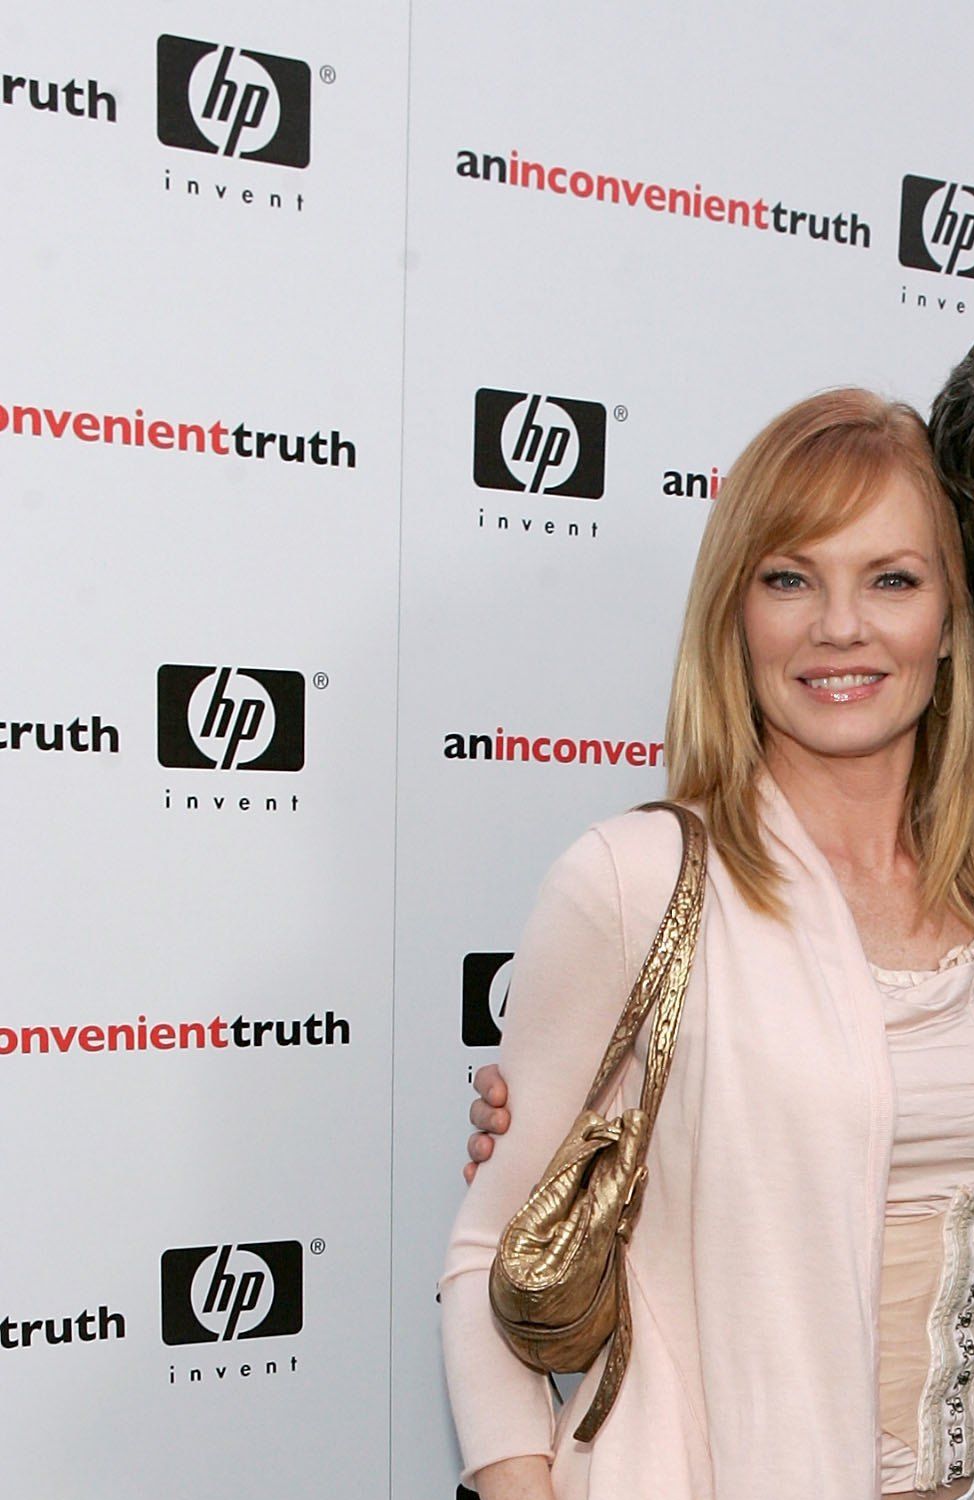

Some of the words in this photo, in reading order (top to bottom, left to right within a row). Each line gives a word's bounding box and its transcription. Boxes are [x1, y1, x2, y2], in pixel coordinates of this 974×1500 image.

[165, 170, 303, 211] invent
[456, 150, 870, 248] aninconvenienttruth
[0, 405, 356, 468] nvenienttruth
[480, 508, 598, 537] invent
[166, 789, 298, 811] invent
[170, 1356, 297, 1384] invent
